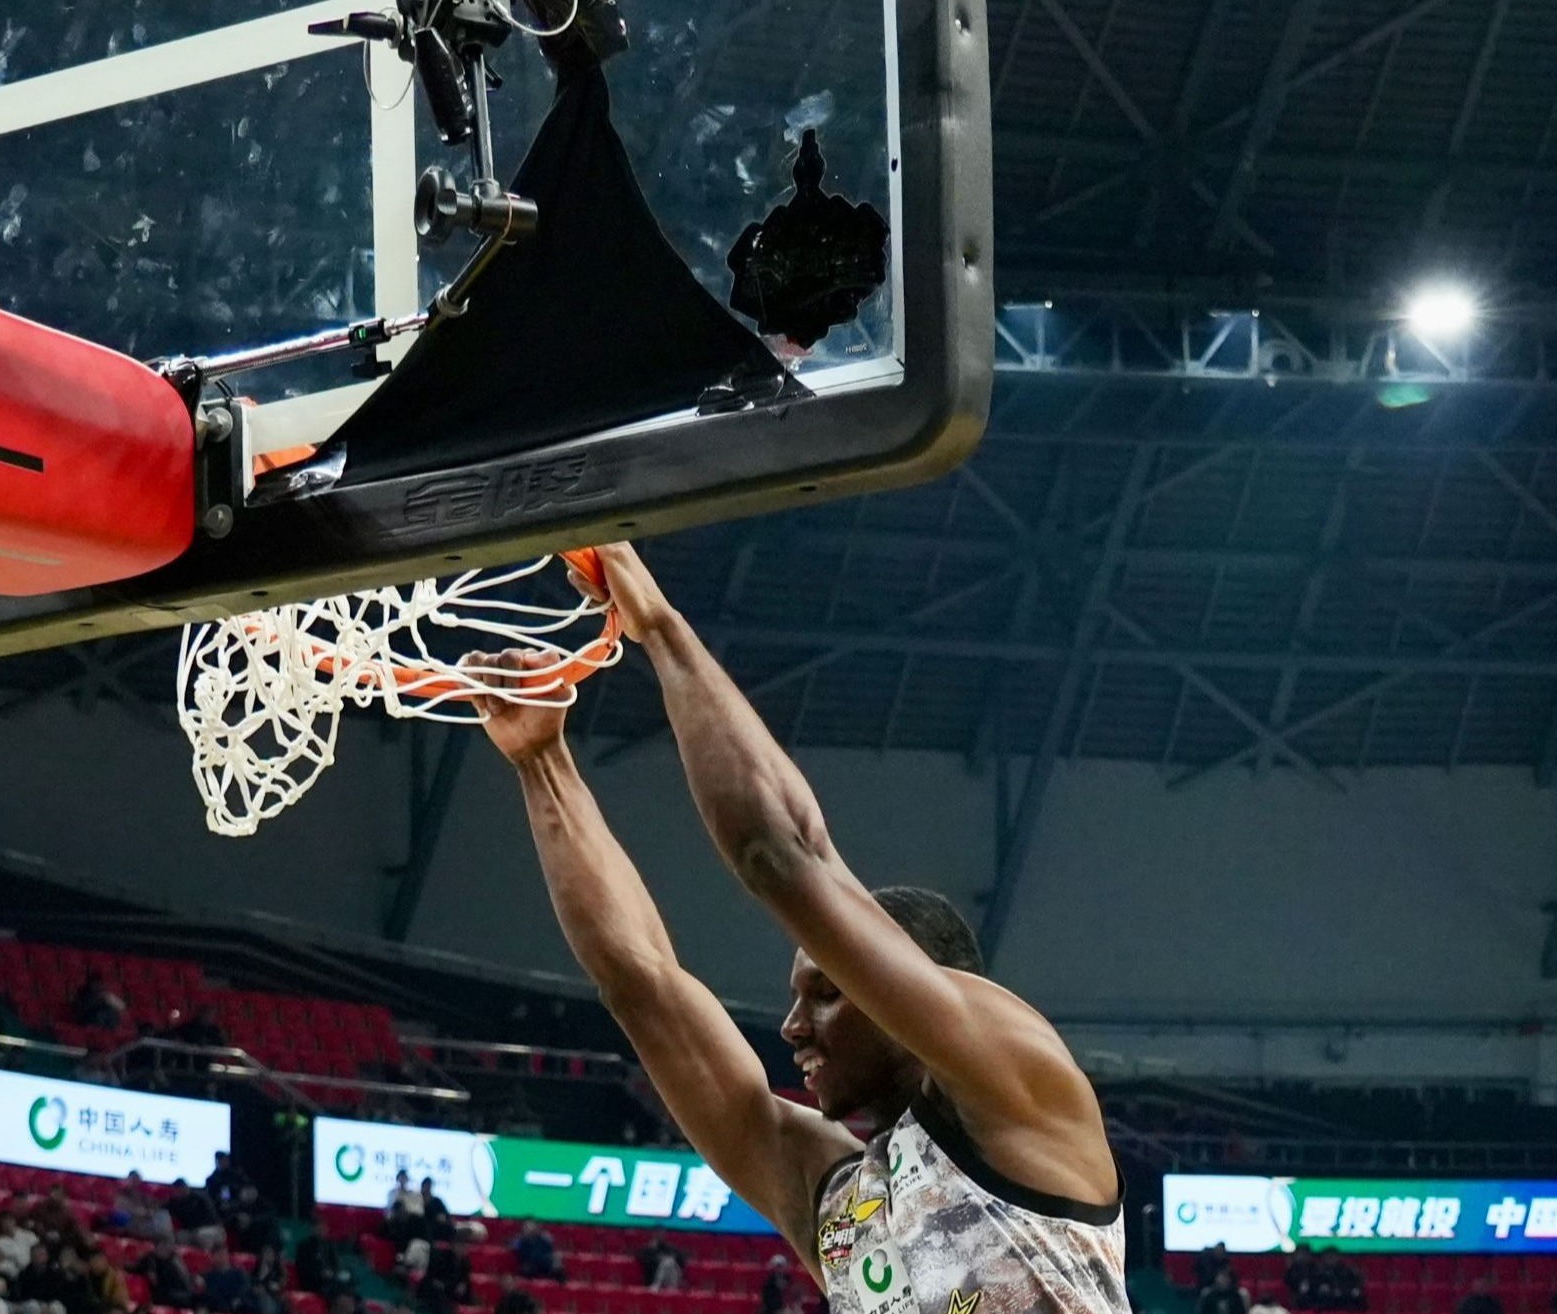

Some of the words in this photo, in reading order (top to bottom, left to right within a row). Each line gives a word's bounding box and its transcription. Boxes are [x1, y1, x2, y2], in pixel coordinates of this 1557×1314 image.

[79, 1105, 180, 1143] 中国人寿
[78, 1137, 135, 1159] CHINA
[142, 1145, 179, 1164] LIFE
[524, 1155, 731, 1222] 一个国寿
[898, 1301, 916, 1314] LIFE
